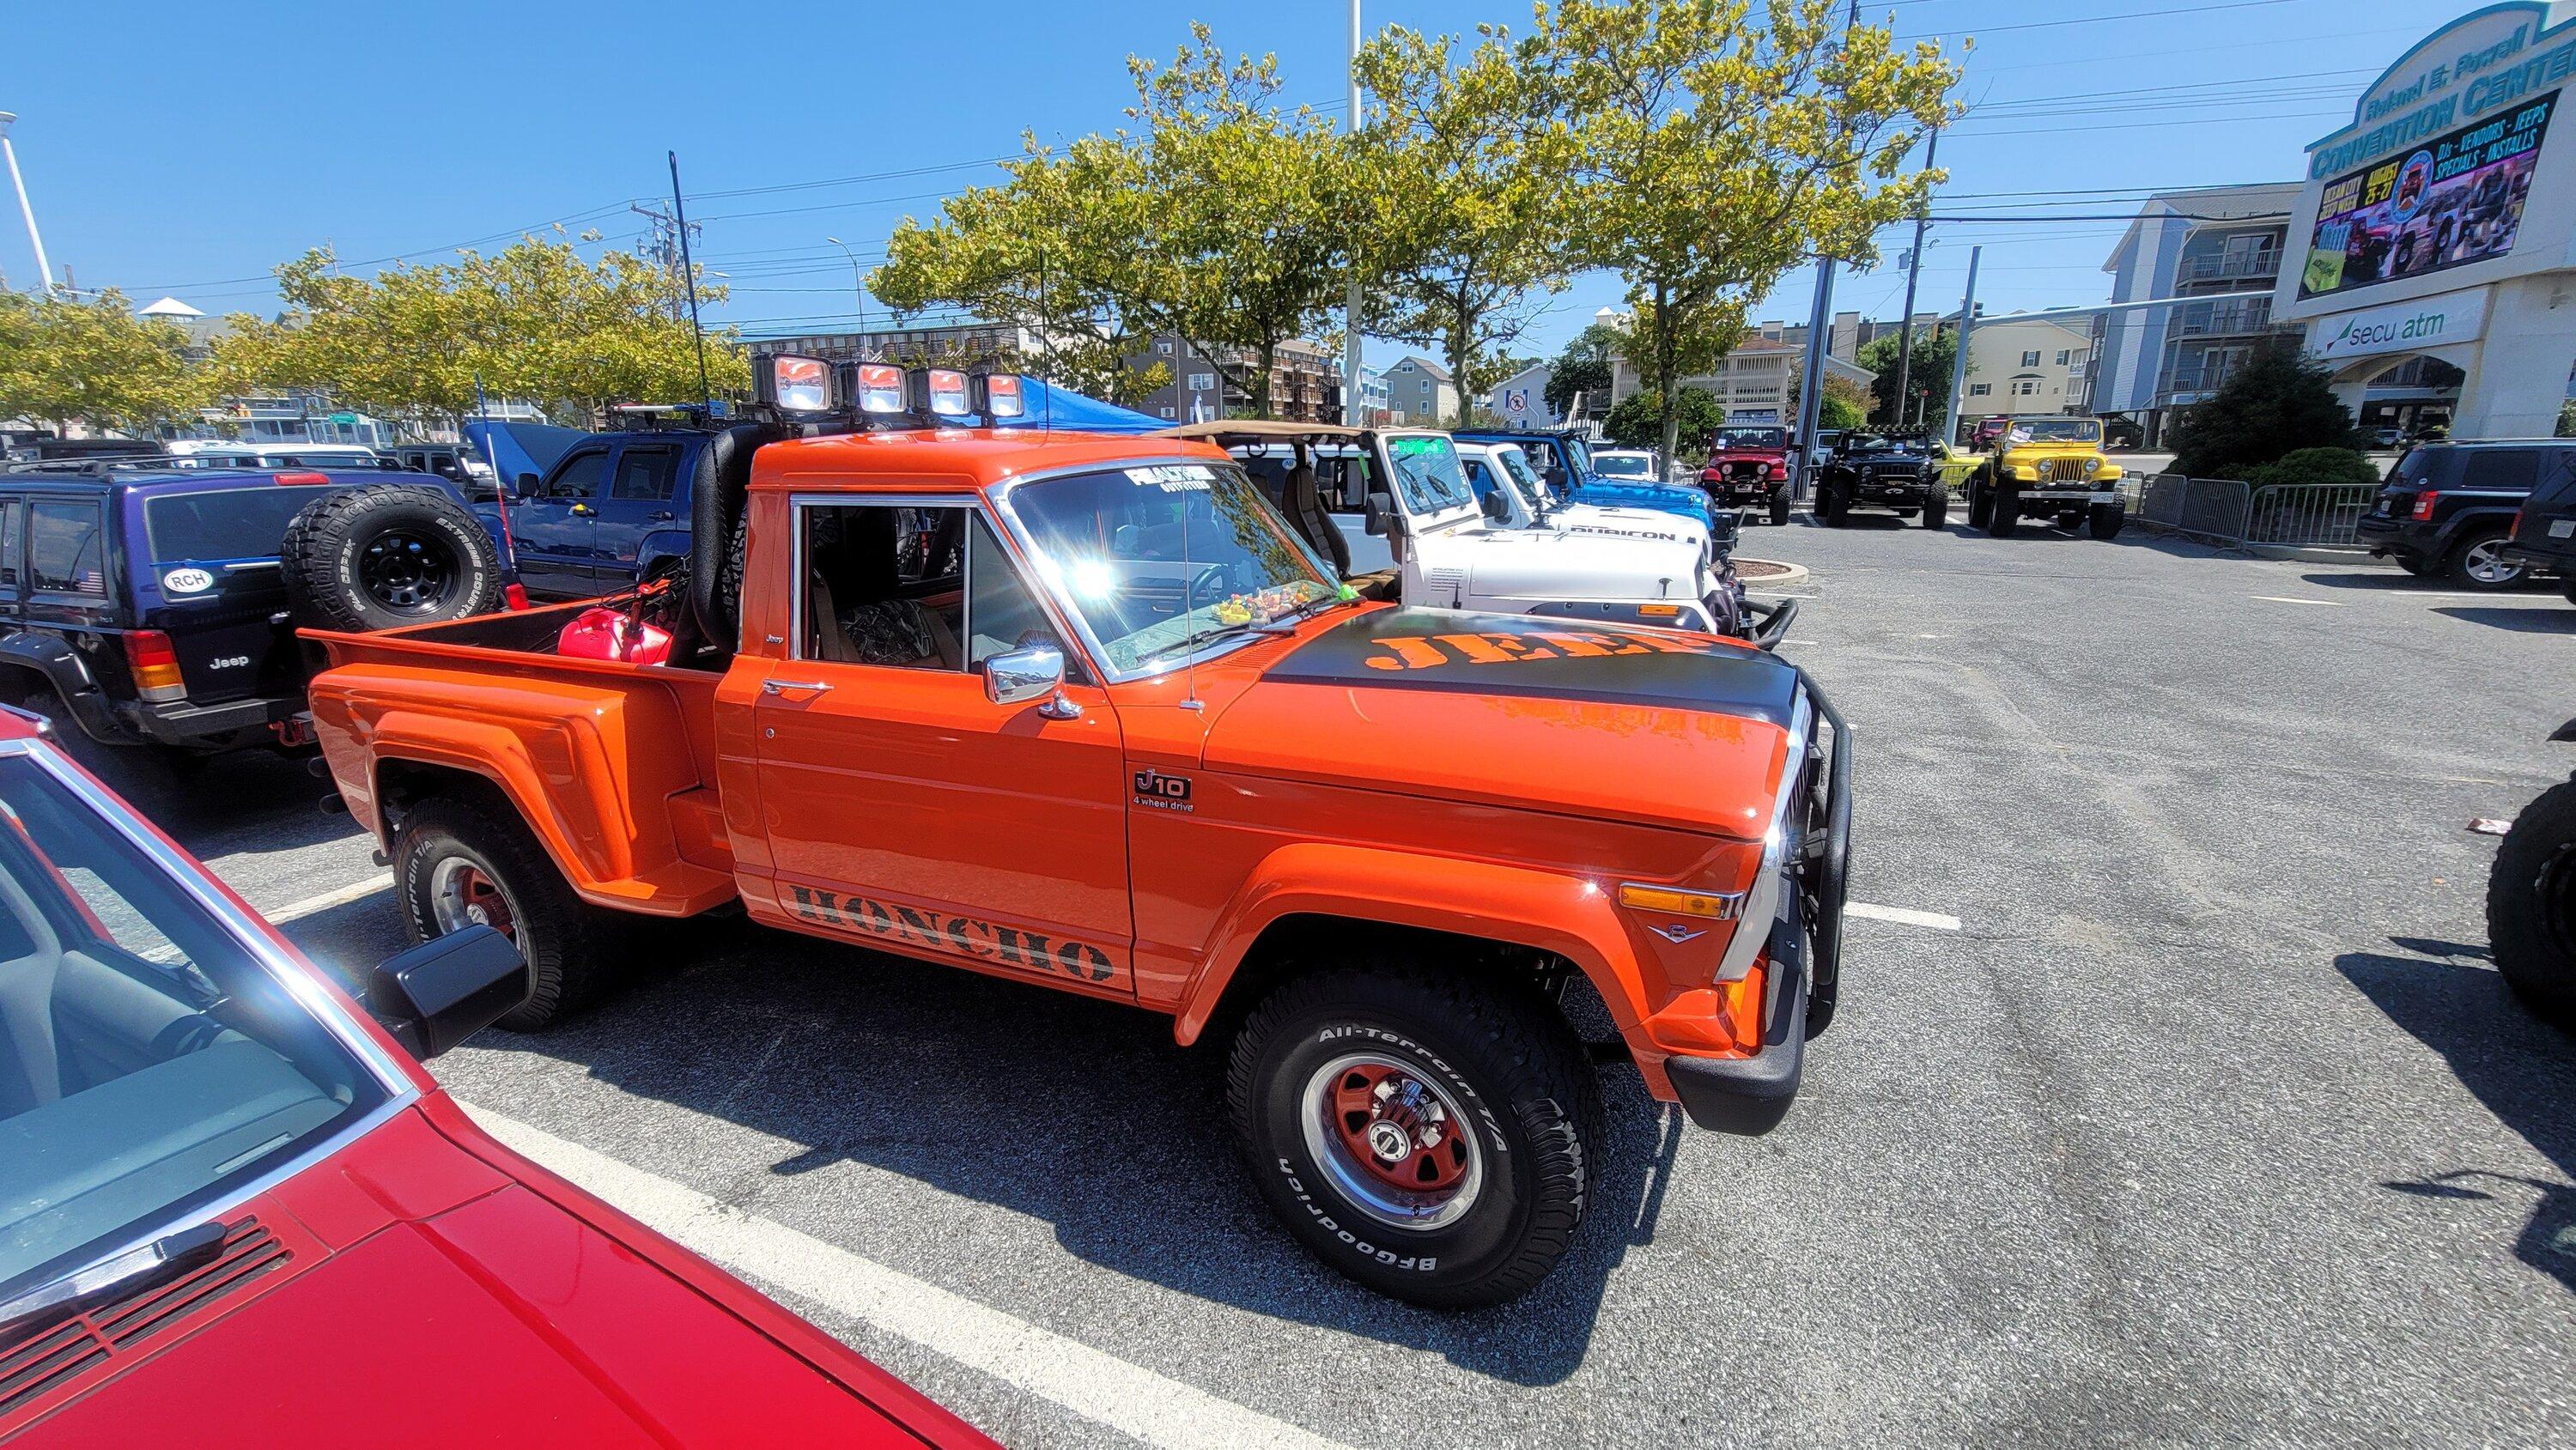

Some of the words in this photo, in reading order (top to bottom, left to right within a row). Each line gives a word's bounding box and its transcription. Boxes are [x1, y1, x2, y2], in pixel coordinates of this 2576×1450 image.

[2455, 23, 2530, 80] Powell
[2311, 93, 2459, 180] CONVENTION
[2459, 118, 2506, 153] VENDORS
[2512, 101, 2549, 133] JEEPS
[2434, 149, 2481, 181] SPECIALS
[2485, 127, 2538, 163] INSTALLS
[2349, 322, 2397, 346] secu
[2402, 312, 2445, 339] atm
[435, 517, 483, 568] EXTREME
[171, 573, 207, 588] RCH
[210, 656, 249, 670] Jeep
[1133, 796, 1139, 804] 4
[1141, 798, 1169, 809] wheel
[1170, 801, 1194, 812] drive
[1136, 769, 1185, 797] J10
[788, 884, 1115, 982] HONCHO
[1318, 1026, 1477, 1098] All-Terrain
[1479, 1107, 1508, 1152] T/A
[1278, 1157, 1437, 1271] BFGoodrich
